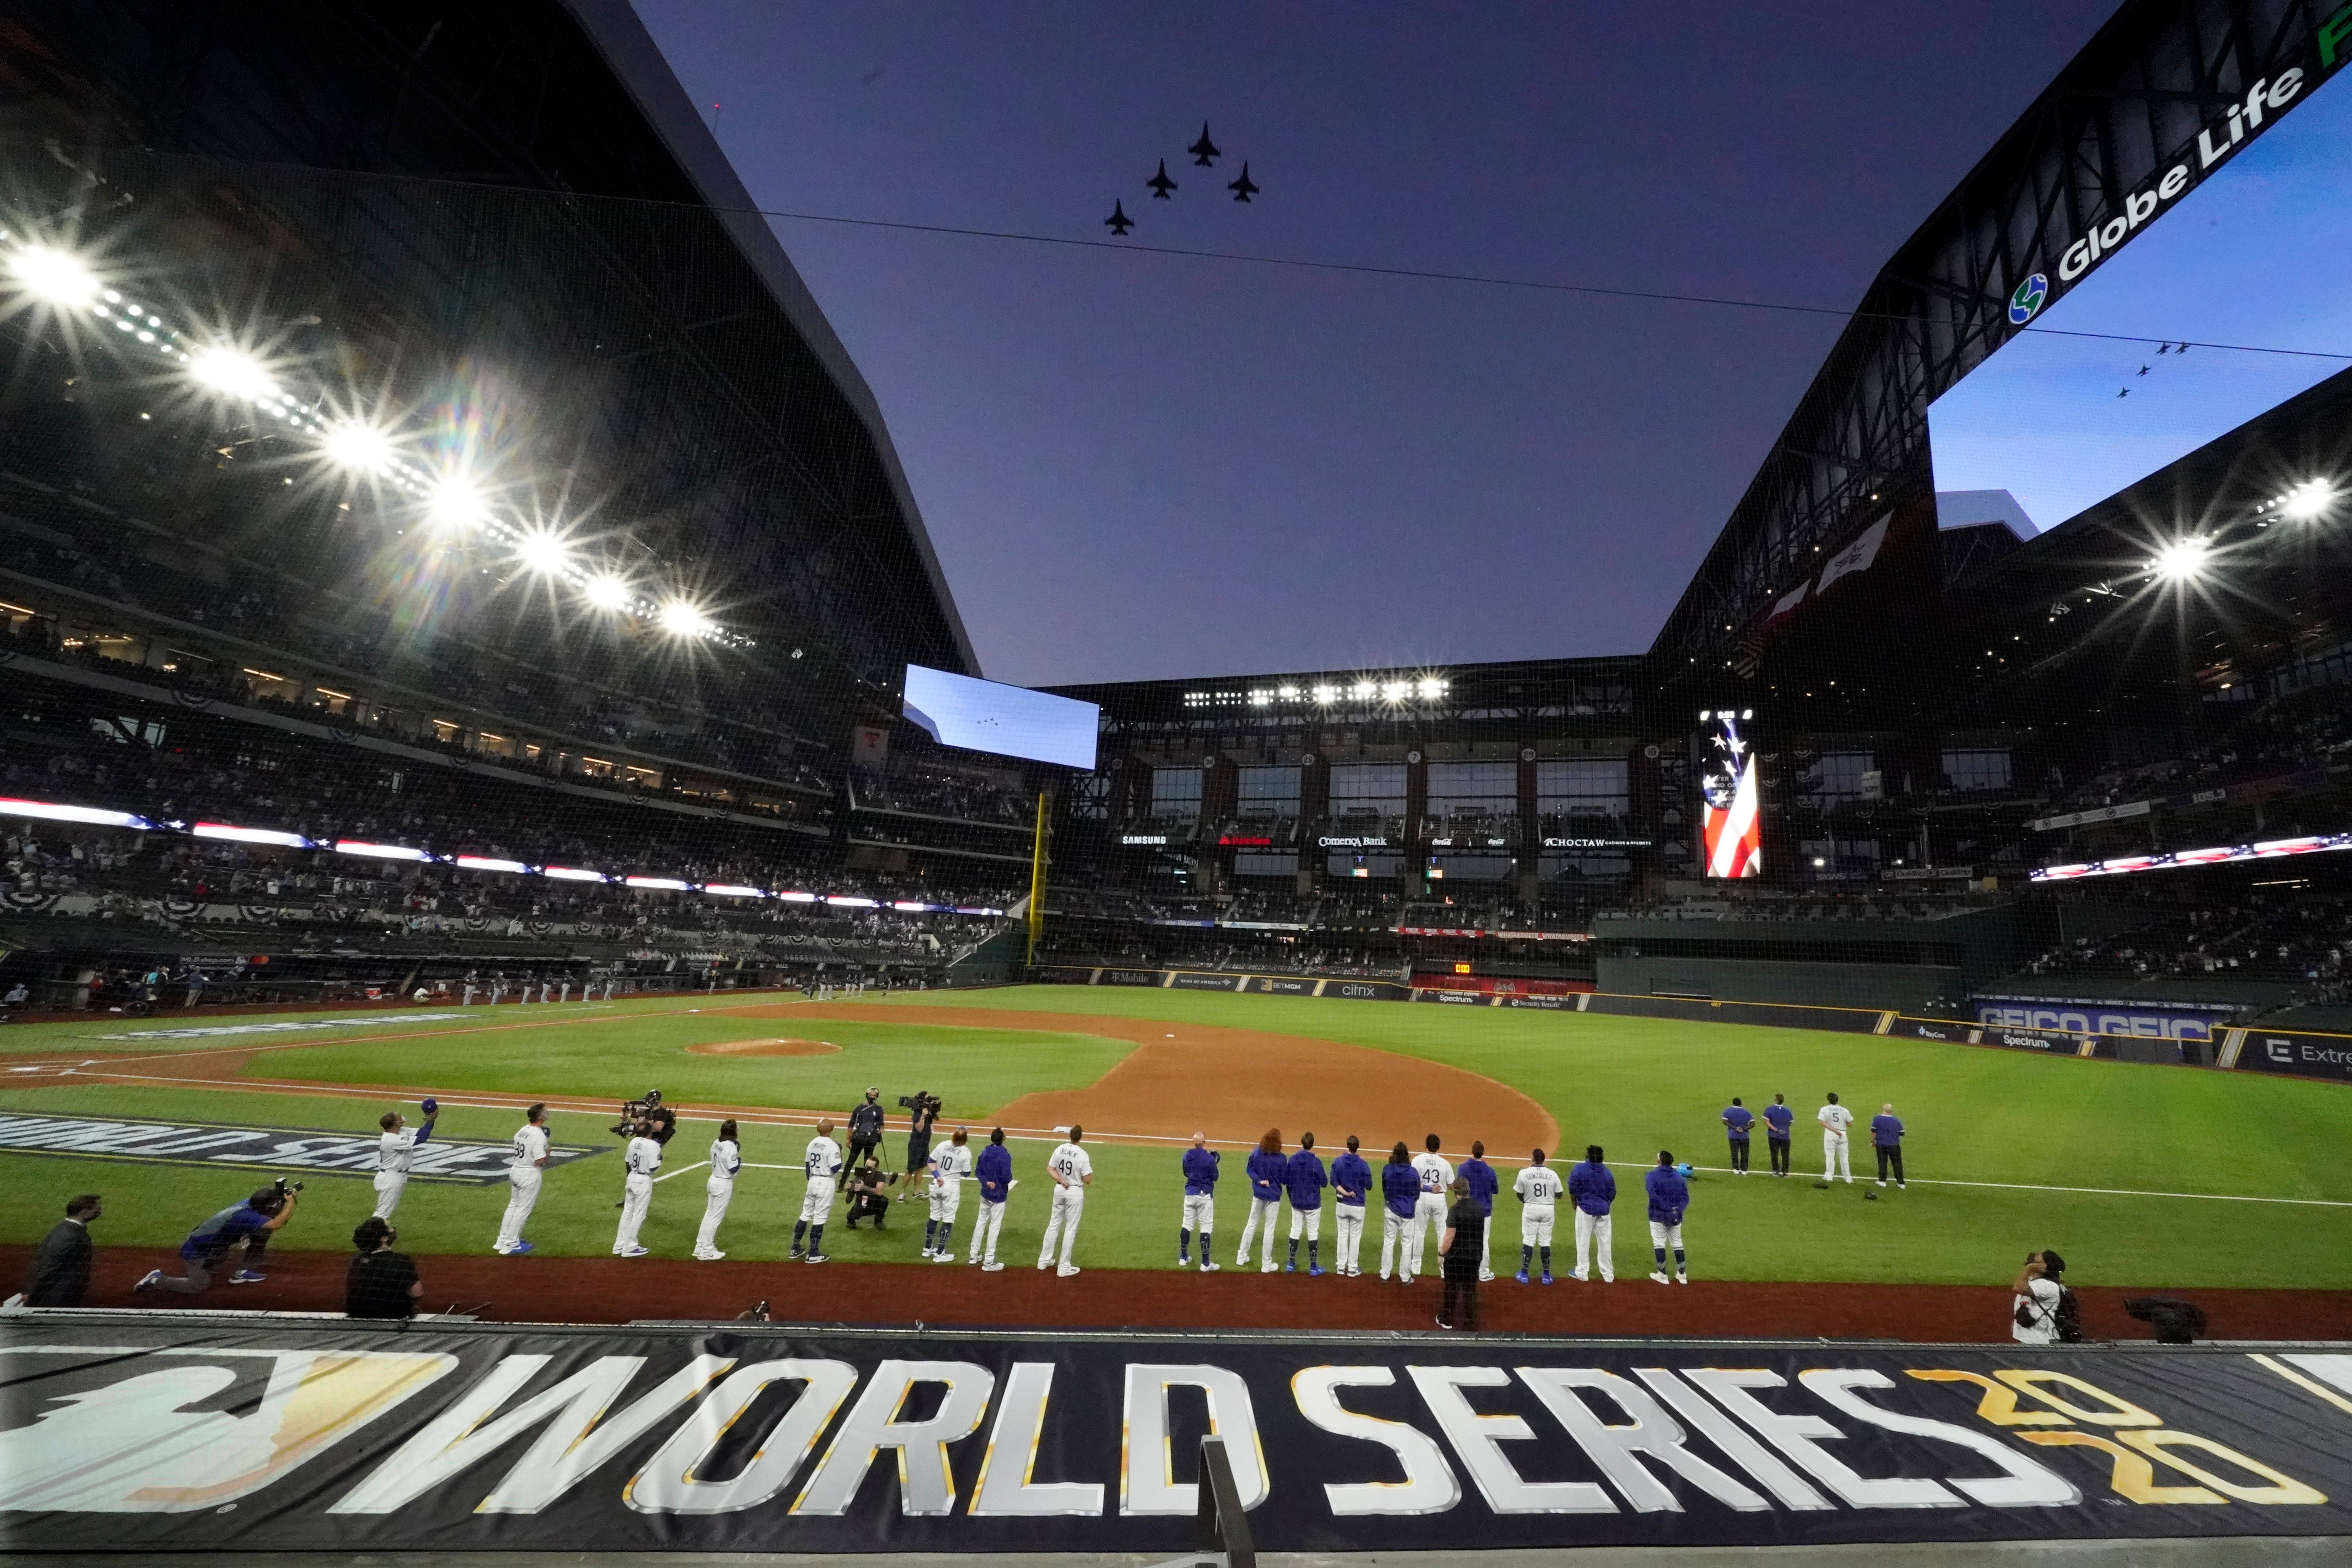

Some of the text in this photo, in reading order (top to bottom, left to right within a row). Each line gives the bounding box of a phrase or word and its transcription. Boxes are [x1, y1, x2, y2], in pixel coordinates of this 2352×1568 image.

[2058, 164, 2187, 281] Globe
[2198, 67, 2304, 169] Life
[1122, 836, 1166, 844] SAMSUNG
[1363, 837, 1387, 845] Bank
[1550, 838, 1605, 847] CHOCTAW
[1440, 994, 1471, 1003] Spectrum
[1980, 1008, 2090, 1040] GEICO
[2003, 1034, 2047, 1048] Spectrum
[1832, 1113, 1840, 1122] 5
[944, 1145, 961, 1156] TURNER
[940, 1155, 953, 1171] 10
[1059, 1159, 1073, 1176] 49
[1422, 1169, 1440, 1184] 43
[1533, 1183, 1547, 1198] 81
[1902, 1368, 2163, 1427] 20
[325, 1354, 2083, 1517] WORLD SERIES
[2016, 1428, 2330, 1504] 20
